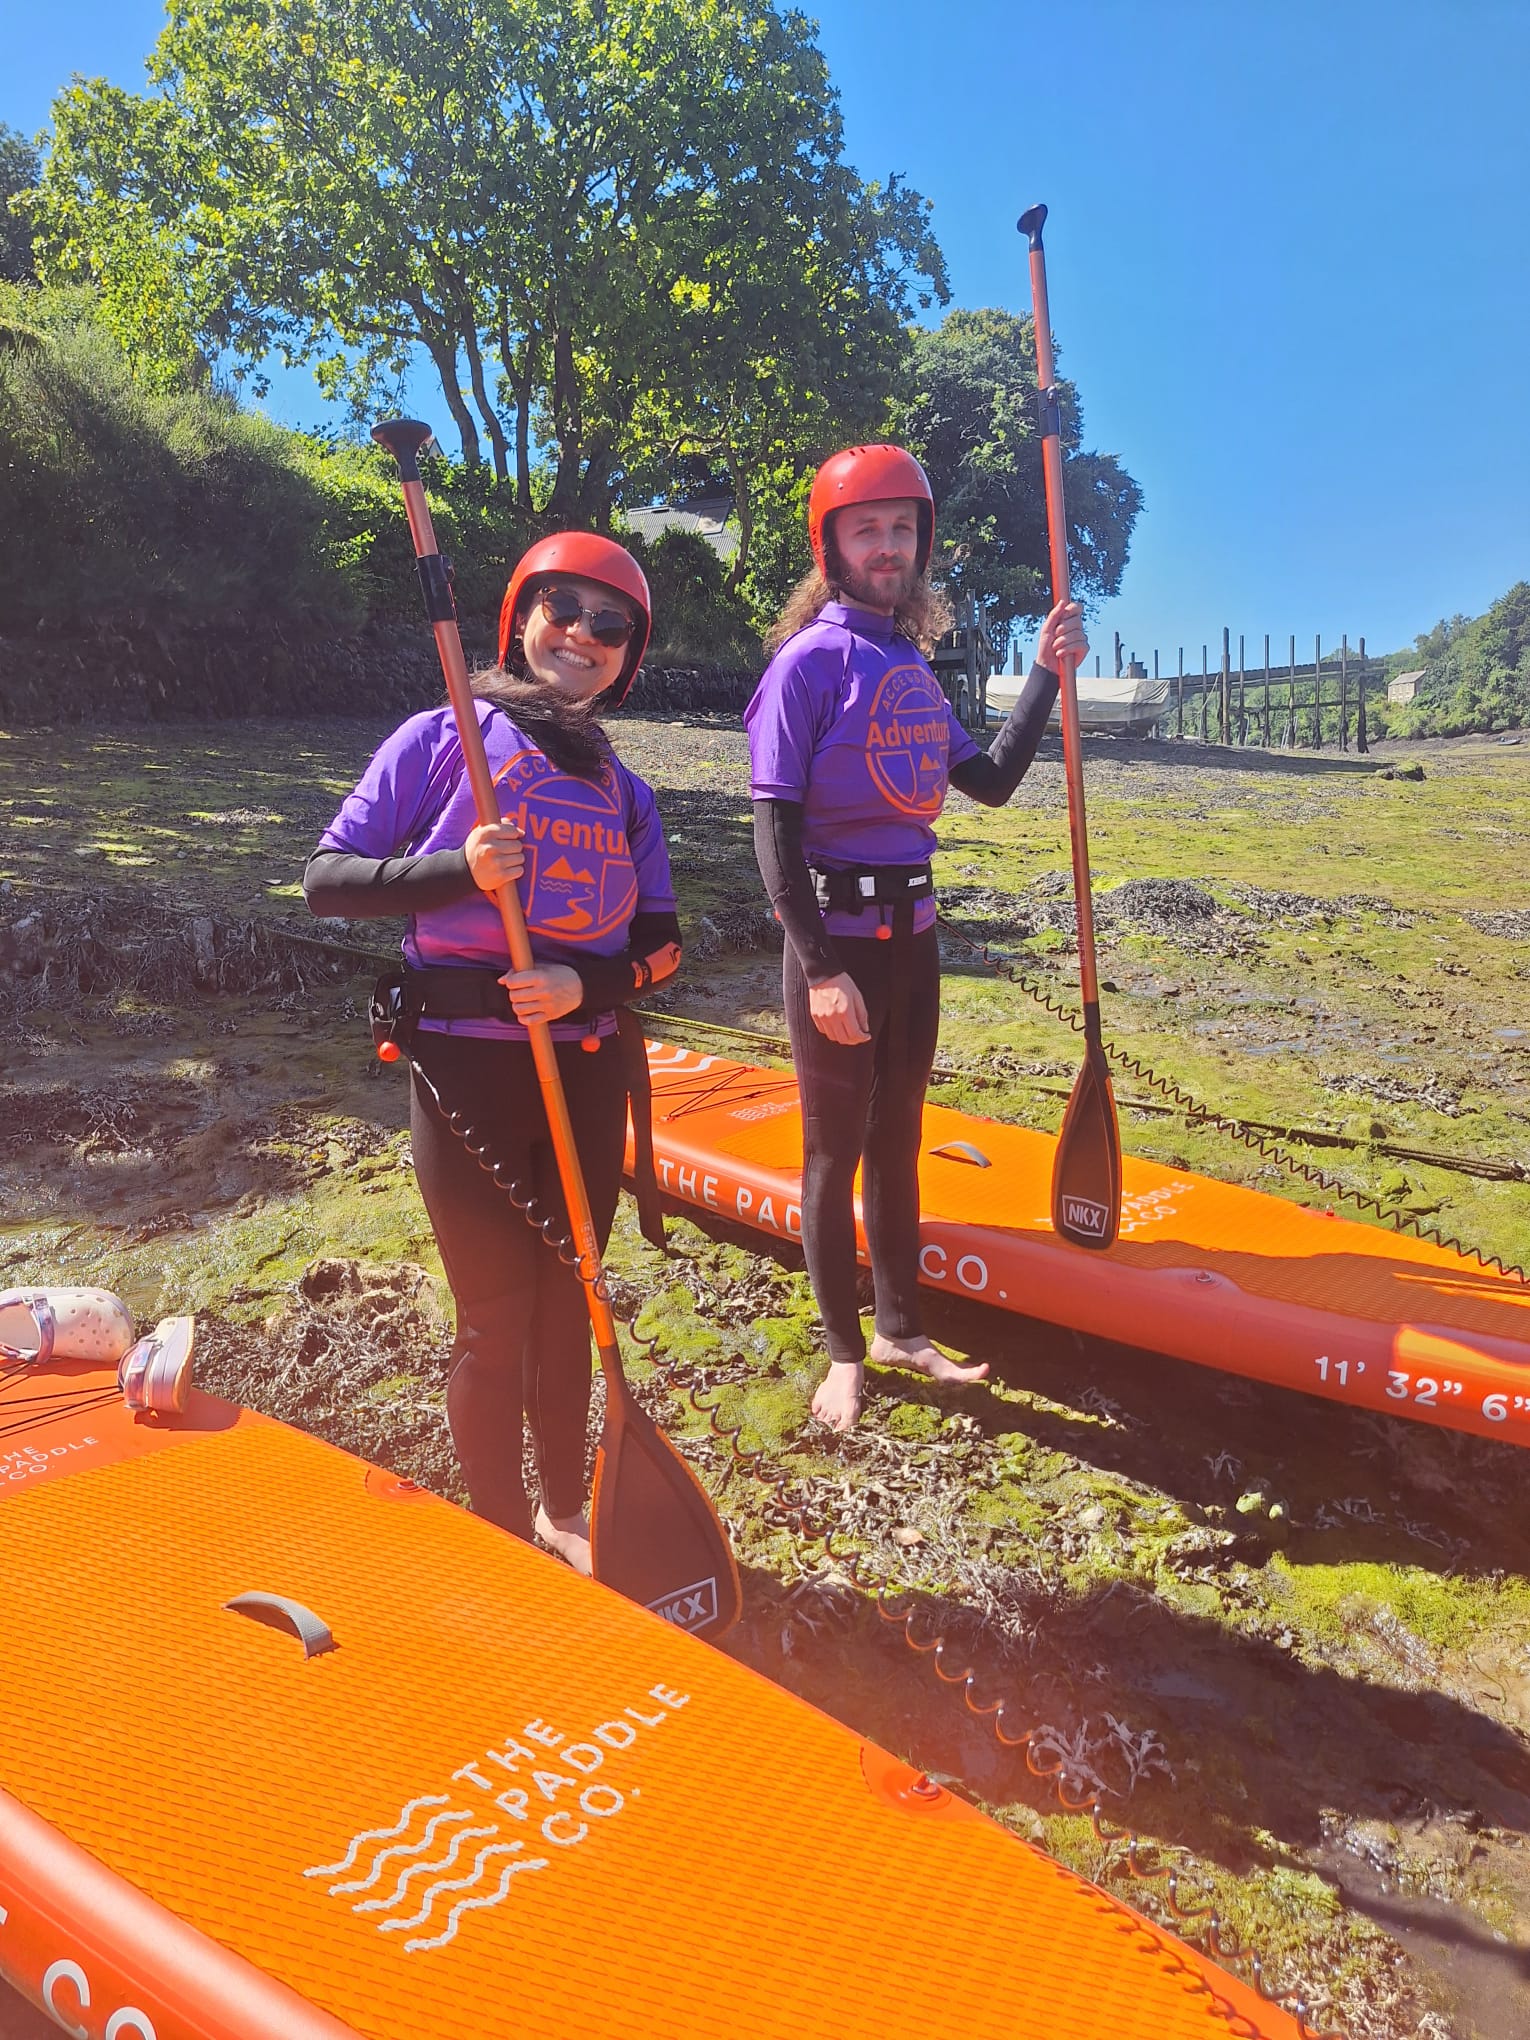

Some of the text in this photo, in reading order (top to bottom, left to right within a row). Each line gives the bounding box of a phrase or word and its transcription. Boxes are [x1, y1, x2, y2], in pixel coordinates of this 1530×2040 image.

[866, 720, 950, 748] Adventur
[504, 802, 630, 857] dventu
[659, 1158, 1008, 1300] THE PAD CO.
[1068, 1203, 1100, 1229] NKX
[2, 1446, 40, 1462] HE
[657, 1591, 707, 1624] KX
[451, 1718, 565, 1790] THE
[495, 1683, 691, 1821] PADDLE
[541, 1784, 641, 1846] CO.
